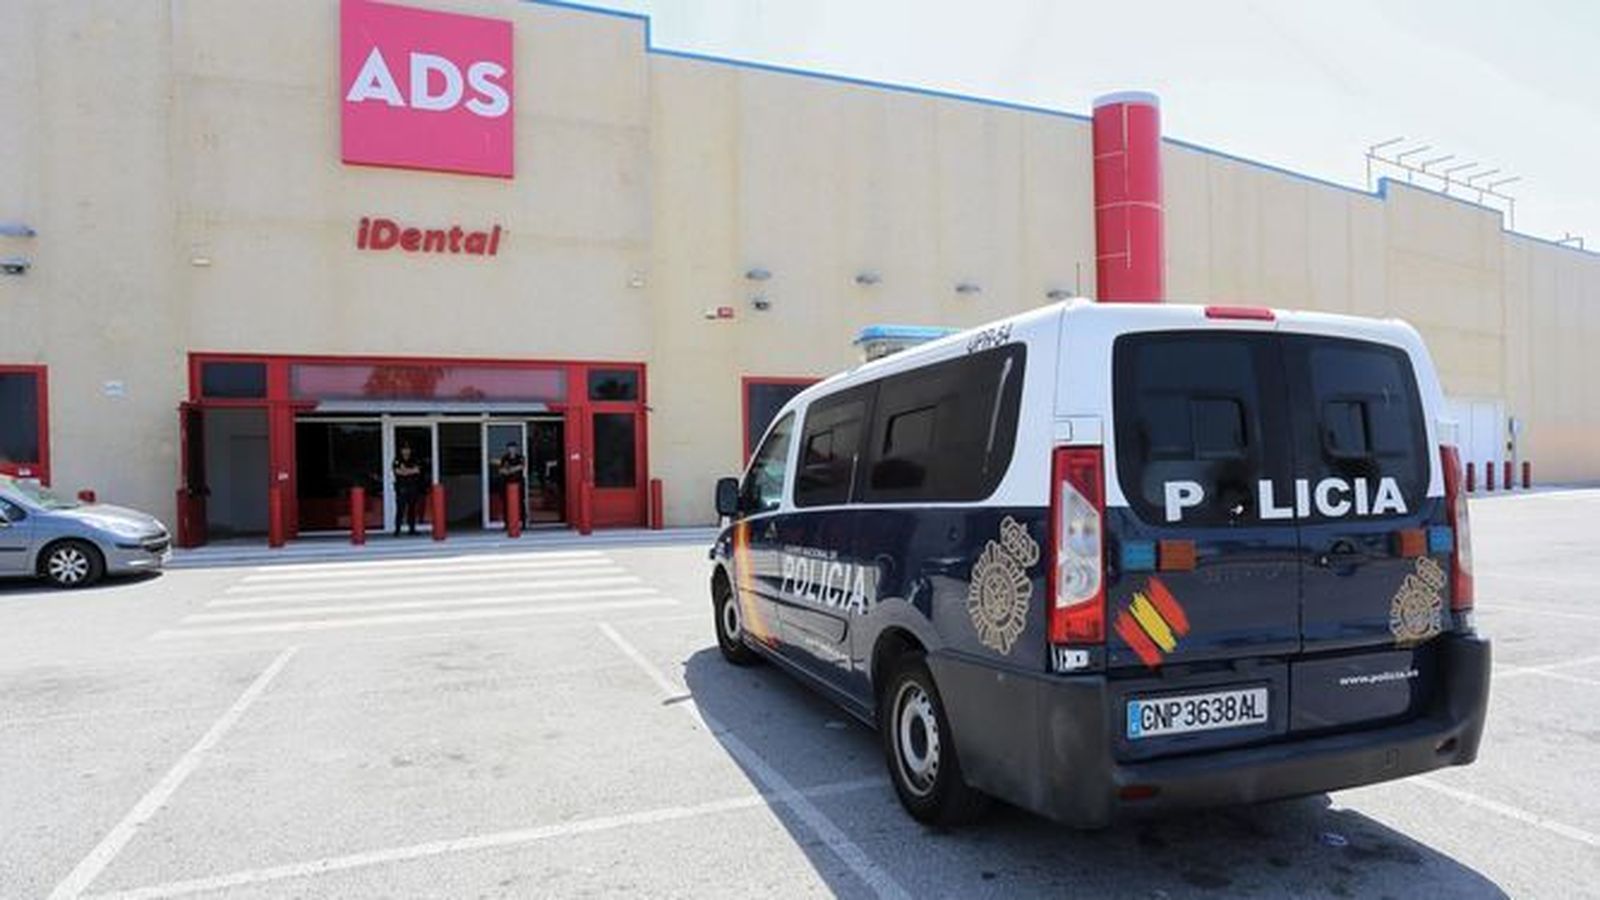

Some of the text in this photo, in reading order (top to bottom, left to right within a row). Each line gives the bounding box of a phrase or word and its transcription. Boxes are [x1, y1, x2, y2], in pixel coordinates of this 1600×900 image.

[346, 46, 510, 117] ADS
[356, 217, 502, 256] iDental
[782, 555, 866, 615] POLICIA
